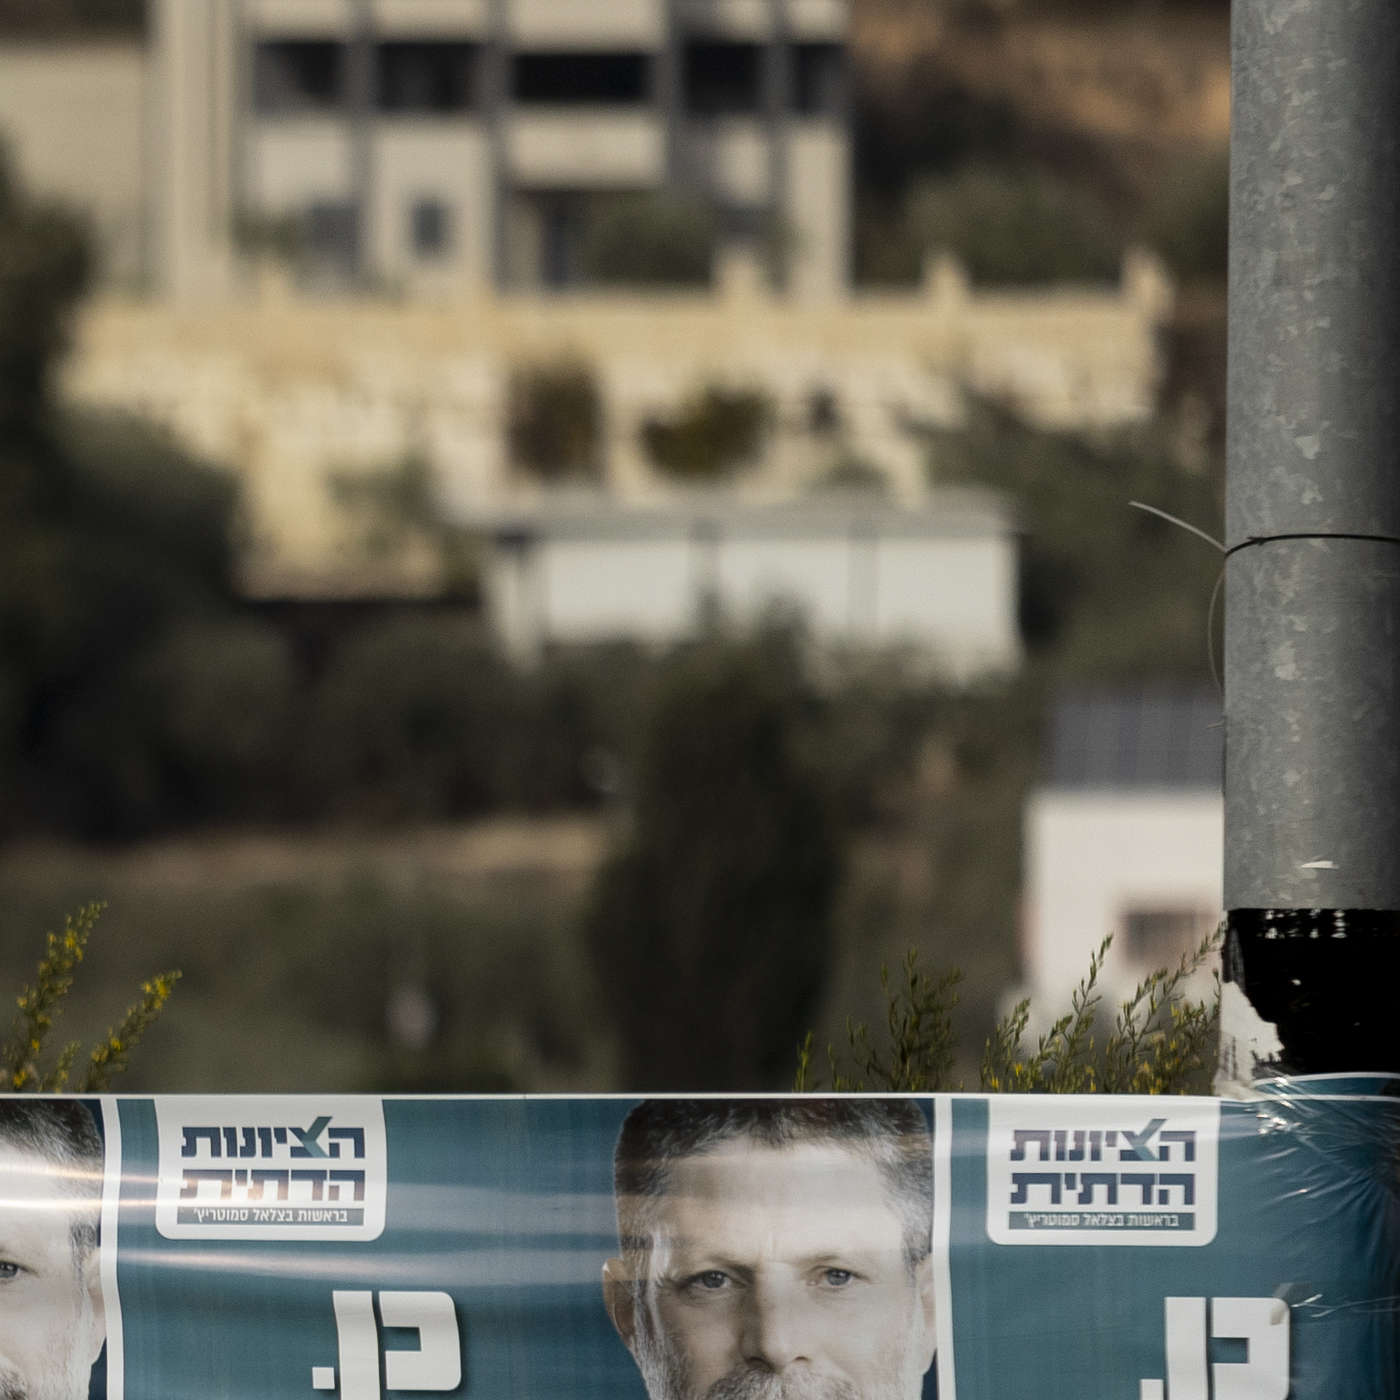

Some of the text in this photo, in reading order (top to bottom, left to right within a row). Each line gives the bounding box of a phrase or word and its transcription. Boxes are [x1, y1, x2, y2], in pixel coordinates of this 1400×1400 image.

[180, 1116, 366, 1159] הציונות
[1009, 1118, 1197, 1162] הציונות
[179, 1169, 366, 1202] הדתית
[1009, 1172, 1196, 1206] הדתית
[252, 1207, 295, 1222] בצלאל
[297, 1208, 349, 1223] בראשות
